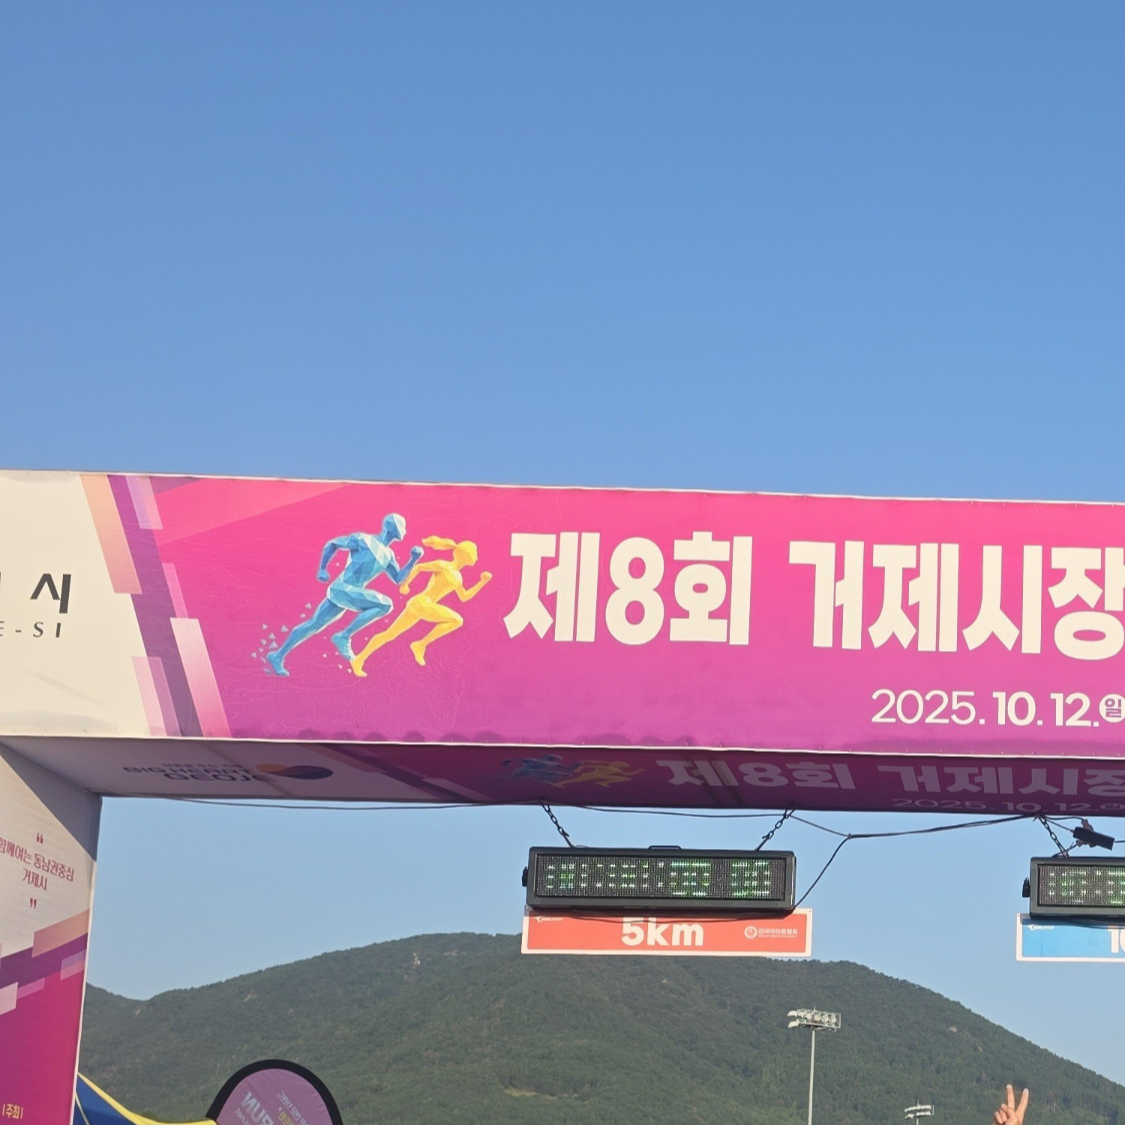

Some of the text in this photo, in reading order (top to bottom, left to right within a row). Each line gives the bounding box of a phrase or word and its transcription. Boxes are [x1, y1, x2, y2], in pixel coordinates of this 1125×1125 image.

[503, 531, 753, 645] 제8회
[656, 759, 856, 790] 제8회
[22, 868, 48, 892] 거제시
[34, 853, 75, 882] 동남권중심
[621, 917, 704, 947] 5km
